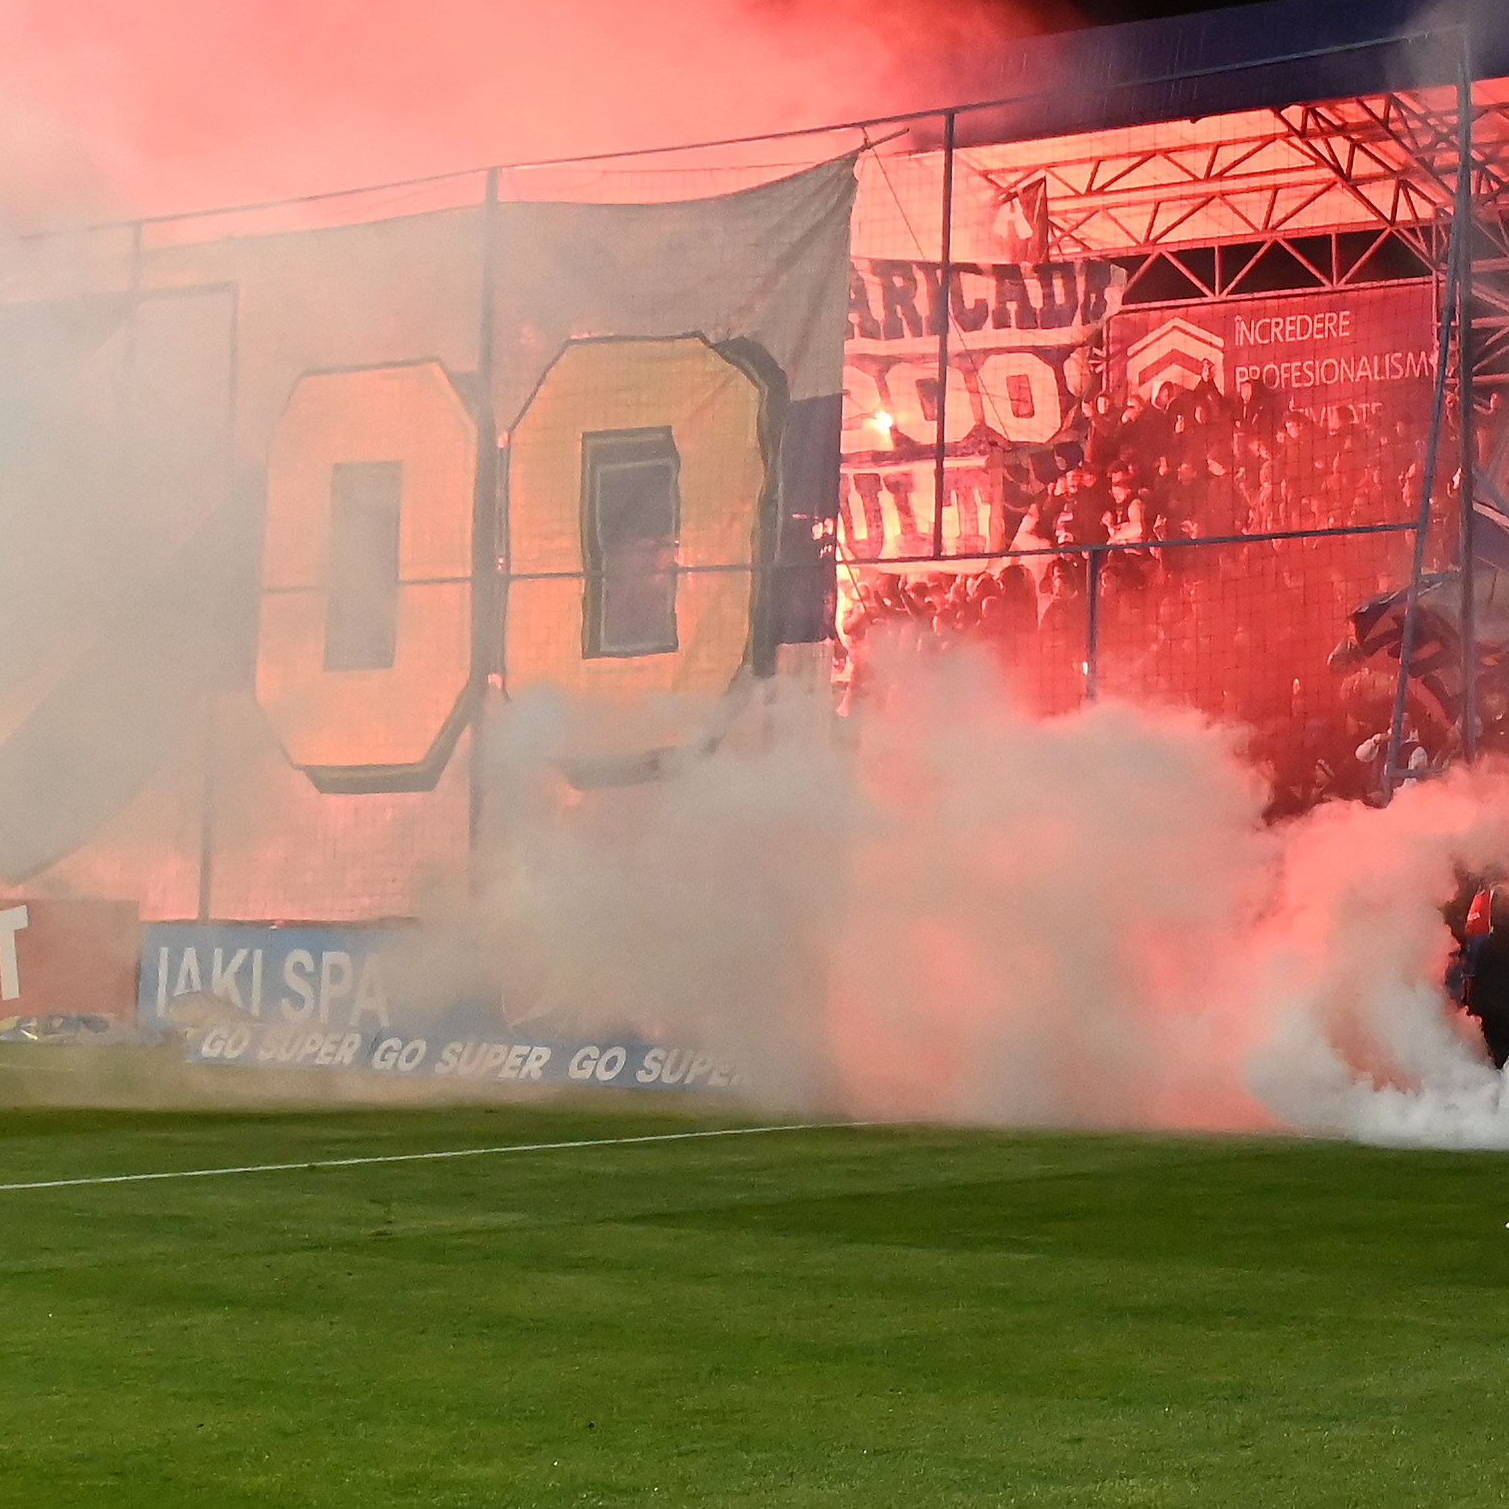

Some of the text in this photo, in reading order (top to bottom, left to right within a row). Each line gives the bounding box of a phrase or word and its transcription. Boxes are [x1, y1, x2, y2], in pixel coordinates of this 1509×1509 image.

[1234, 310, 1351, 347] ÎNCREDERE
[201, 1025, 252, 1059] GO
[257, 1031, 362, 1065] SUPER
[371, 1037, 427, 1072] GO
[435, 1041, 552, 1080] SUPER
[568, 1046, 627, 1082] GO
